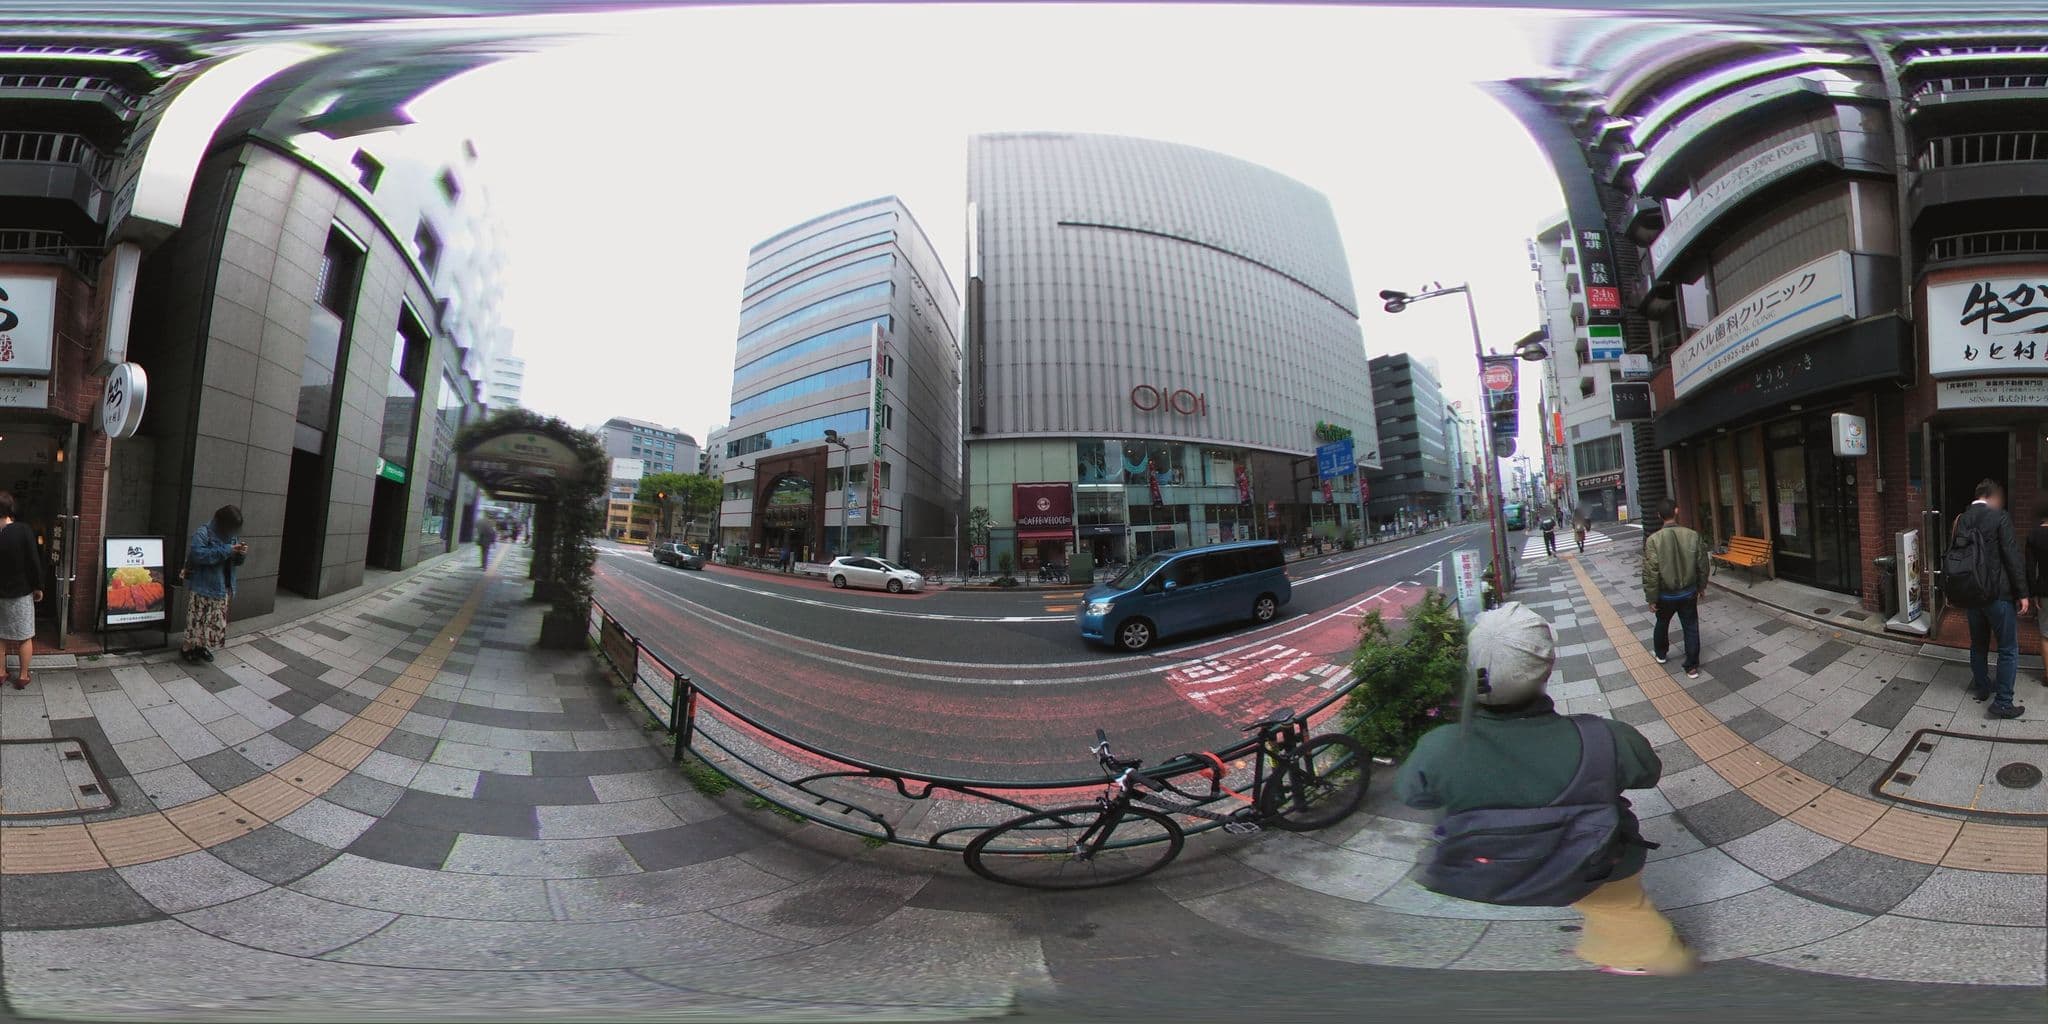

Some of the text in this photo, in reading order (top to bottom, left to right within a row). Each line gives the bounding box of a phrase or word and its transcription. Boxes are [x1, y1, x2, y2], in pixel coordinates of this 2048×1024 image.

[1592, 289, 1614, 298] 24h
[1688, 273, 1816, 361] スバル歯科クリニック
[1963, 340, 2037, 361] もと村
